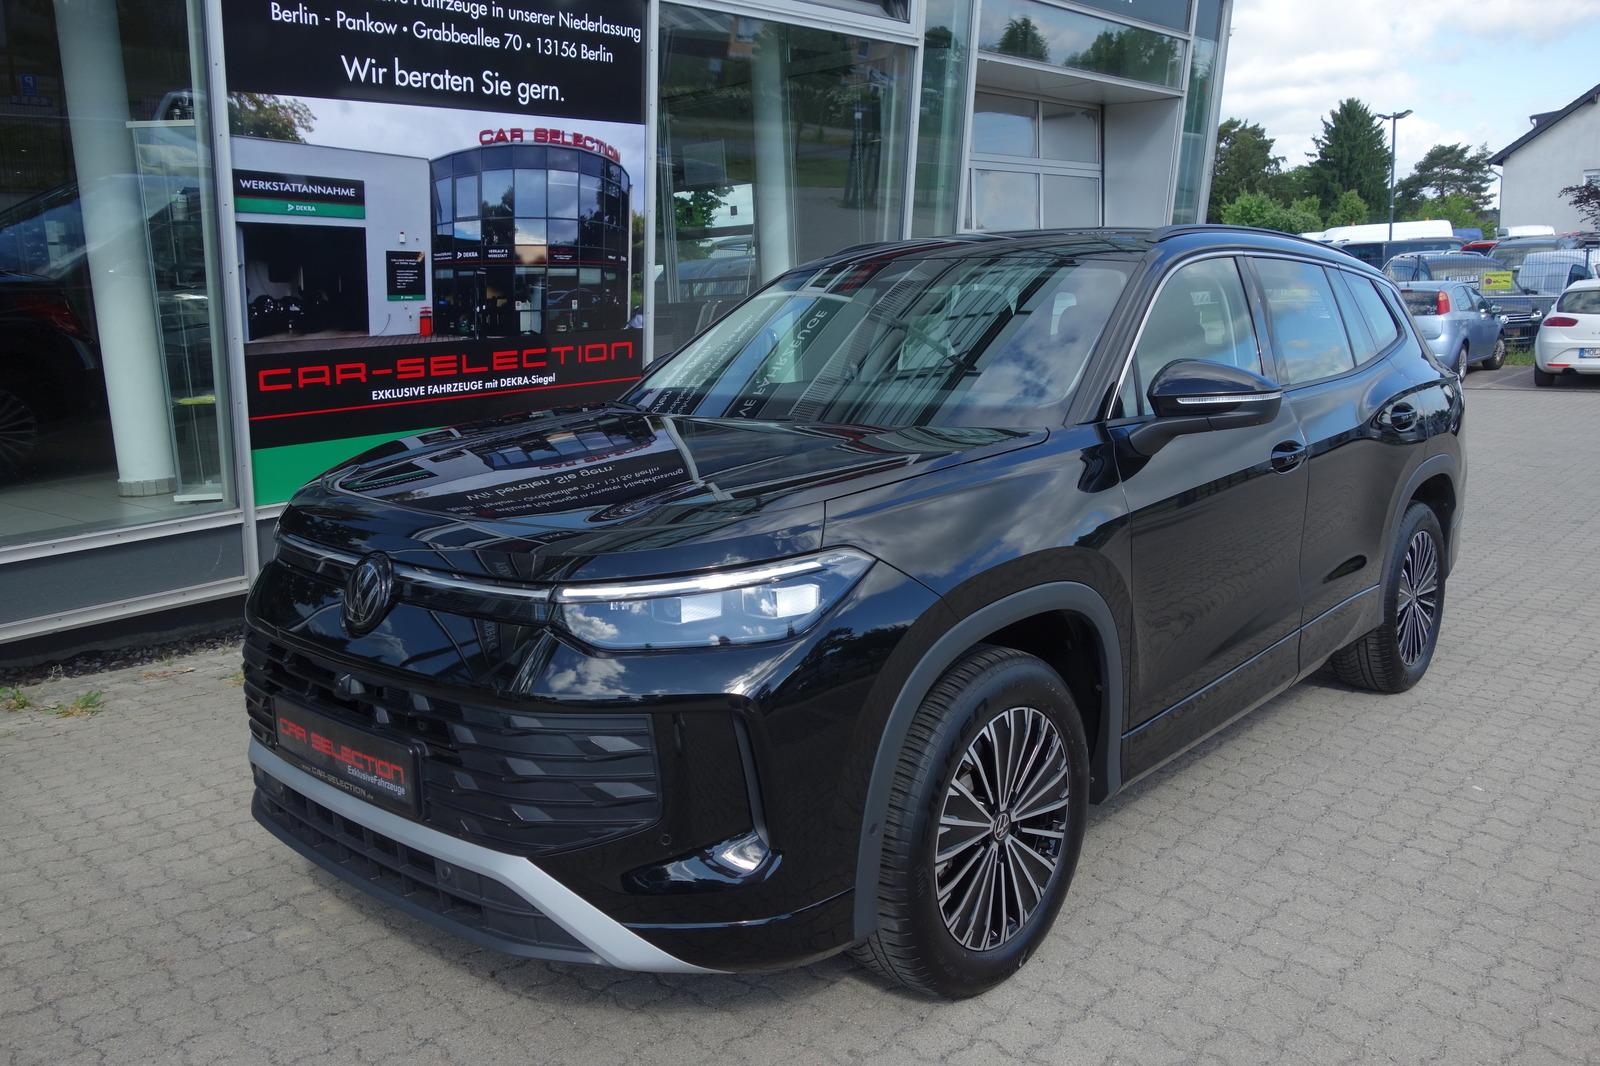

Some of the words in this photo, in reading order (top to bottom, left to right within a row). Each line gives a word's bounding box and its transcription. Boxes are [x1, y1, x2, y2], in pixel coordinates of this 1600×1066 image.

[270, 2, 319, 26] Berlin
[336, 10, 398, 35] Pankow
[412, 20, 501, 49] Grabbeallee
[503, 32, 523, 51] 70
[536, 37, 578, 59] 13156
[580, 43, 614, 63] Berlin
[491, 1, 504, 18] in
[508, 8, 555, 26] unserer
[558, 10, 641, 44] Niederlassung
[340, 54, 388, 85] Wir
[394, 57, 475, 93] beraten
[481, 70, 512, 97] Sie
[517, 82, 565, 106] gern.
[479, 128, 524, 145] CAR
[533, 128, 621, 161] SELECTION
[240, 179, 356, 197] WERKSTATTANNAHME
[295, 204, 316, 212] DEKRA
[258, 341, 633, 392] CAR-SELECTION
[371, 385, 425, 401] EXKLUSIVE
[427, 380, 483, 395] FAHRZEUGE
[485, 378, 498, 389] mit
[500, 372, 556, 389] DEKRA-Siegel
[278, 717, 308, 744] CAR
[311, 731, 405, 784] SELECTION
